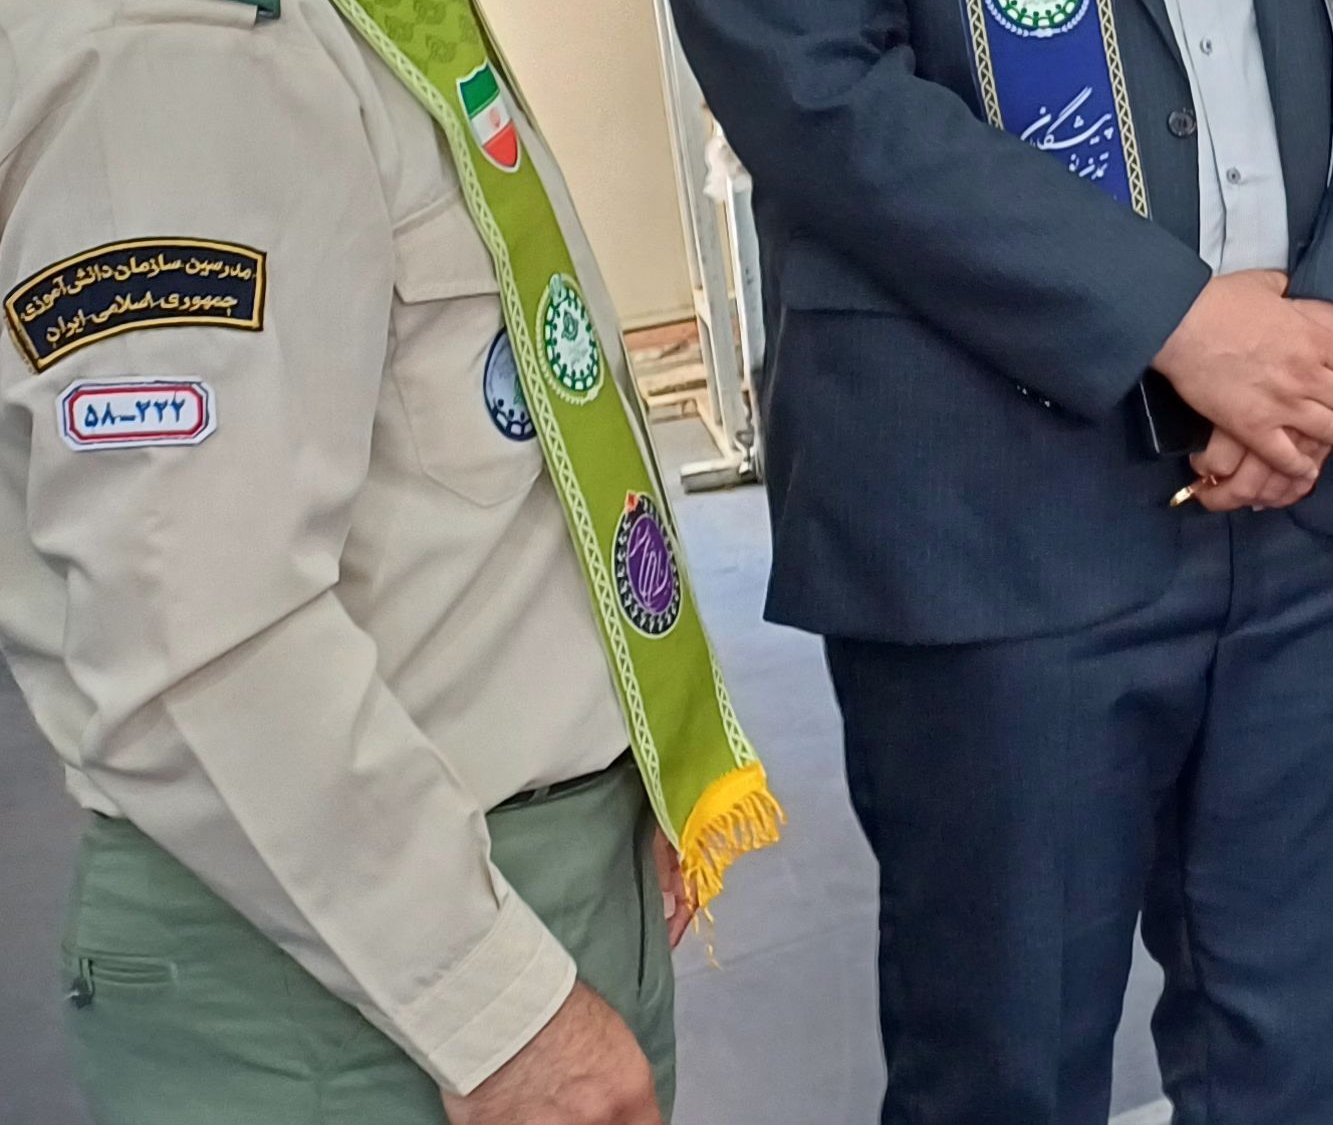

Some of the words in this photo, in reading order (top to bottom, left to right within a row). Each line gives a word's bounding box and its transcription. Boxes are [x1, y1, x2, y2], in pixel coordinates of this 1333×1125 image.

[114, 253, 182, 281] سازمان
[185, 256, 252, 281] مدرسین
[160, 291, 238, 317] جمهوری
[45, 308, 85, 349] ایران
